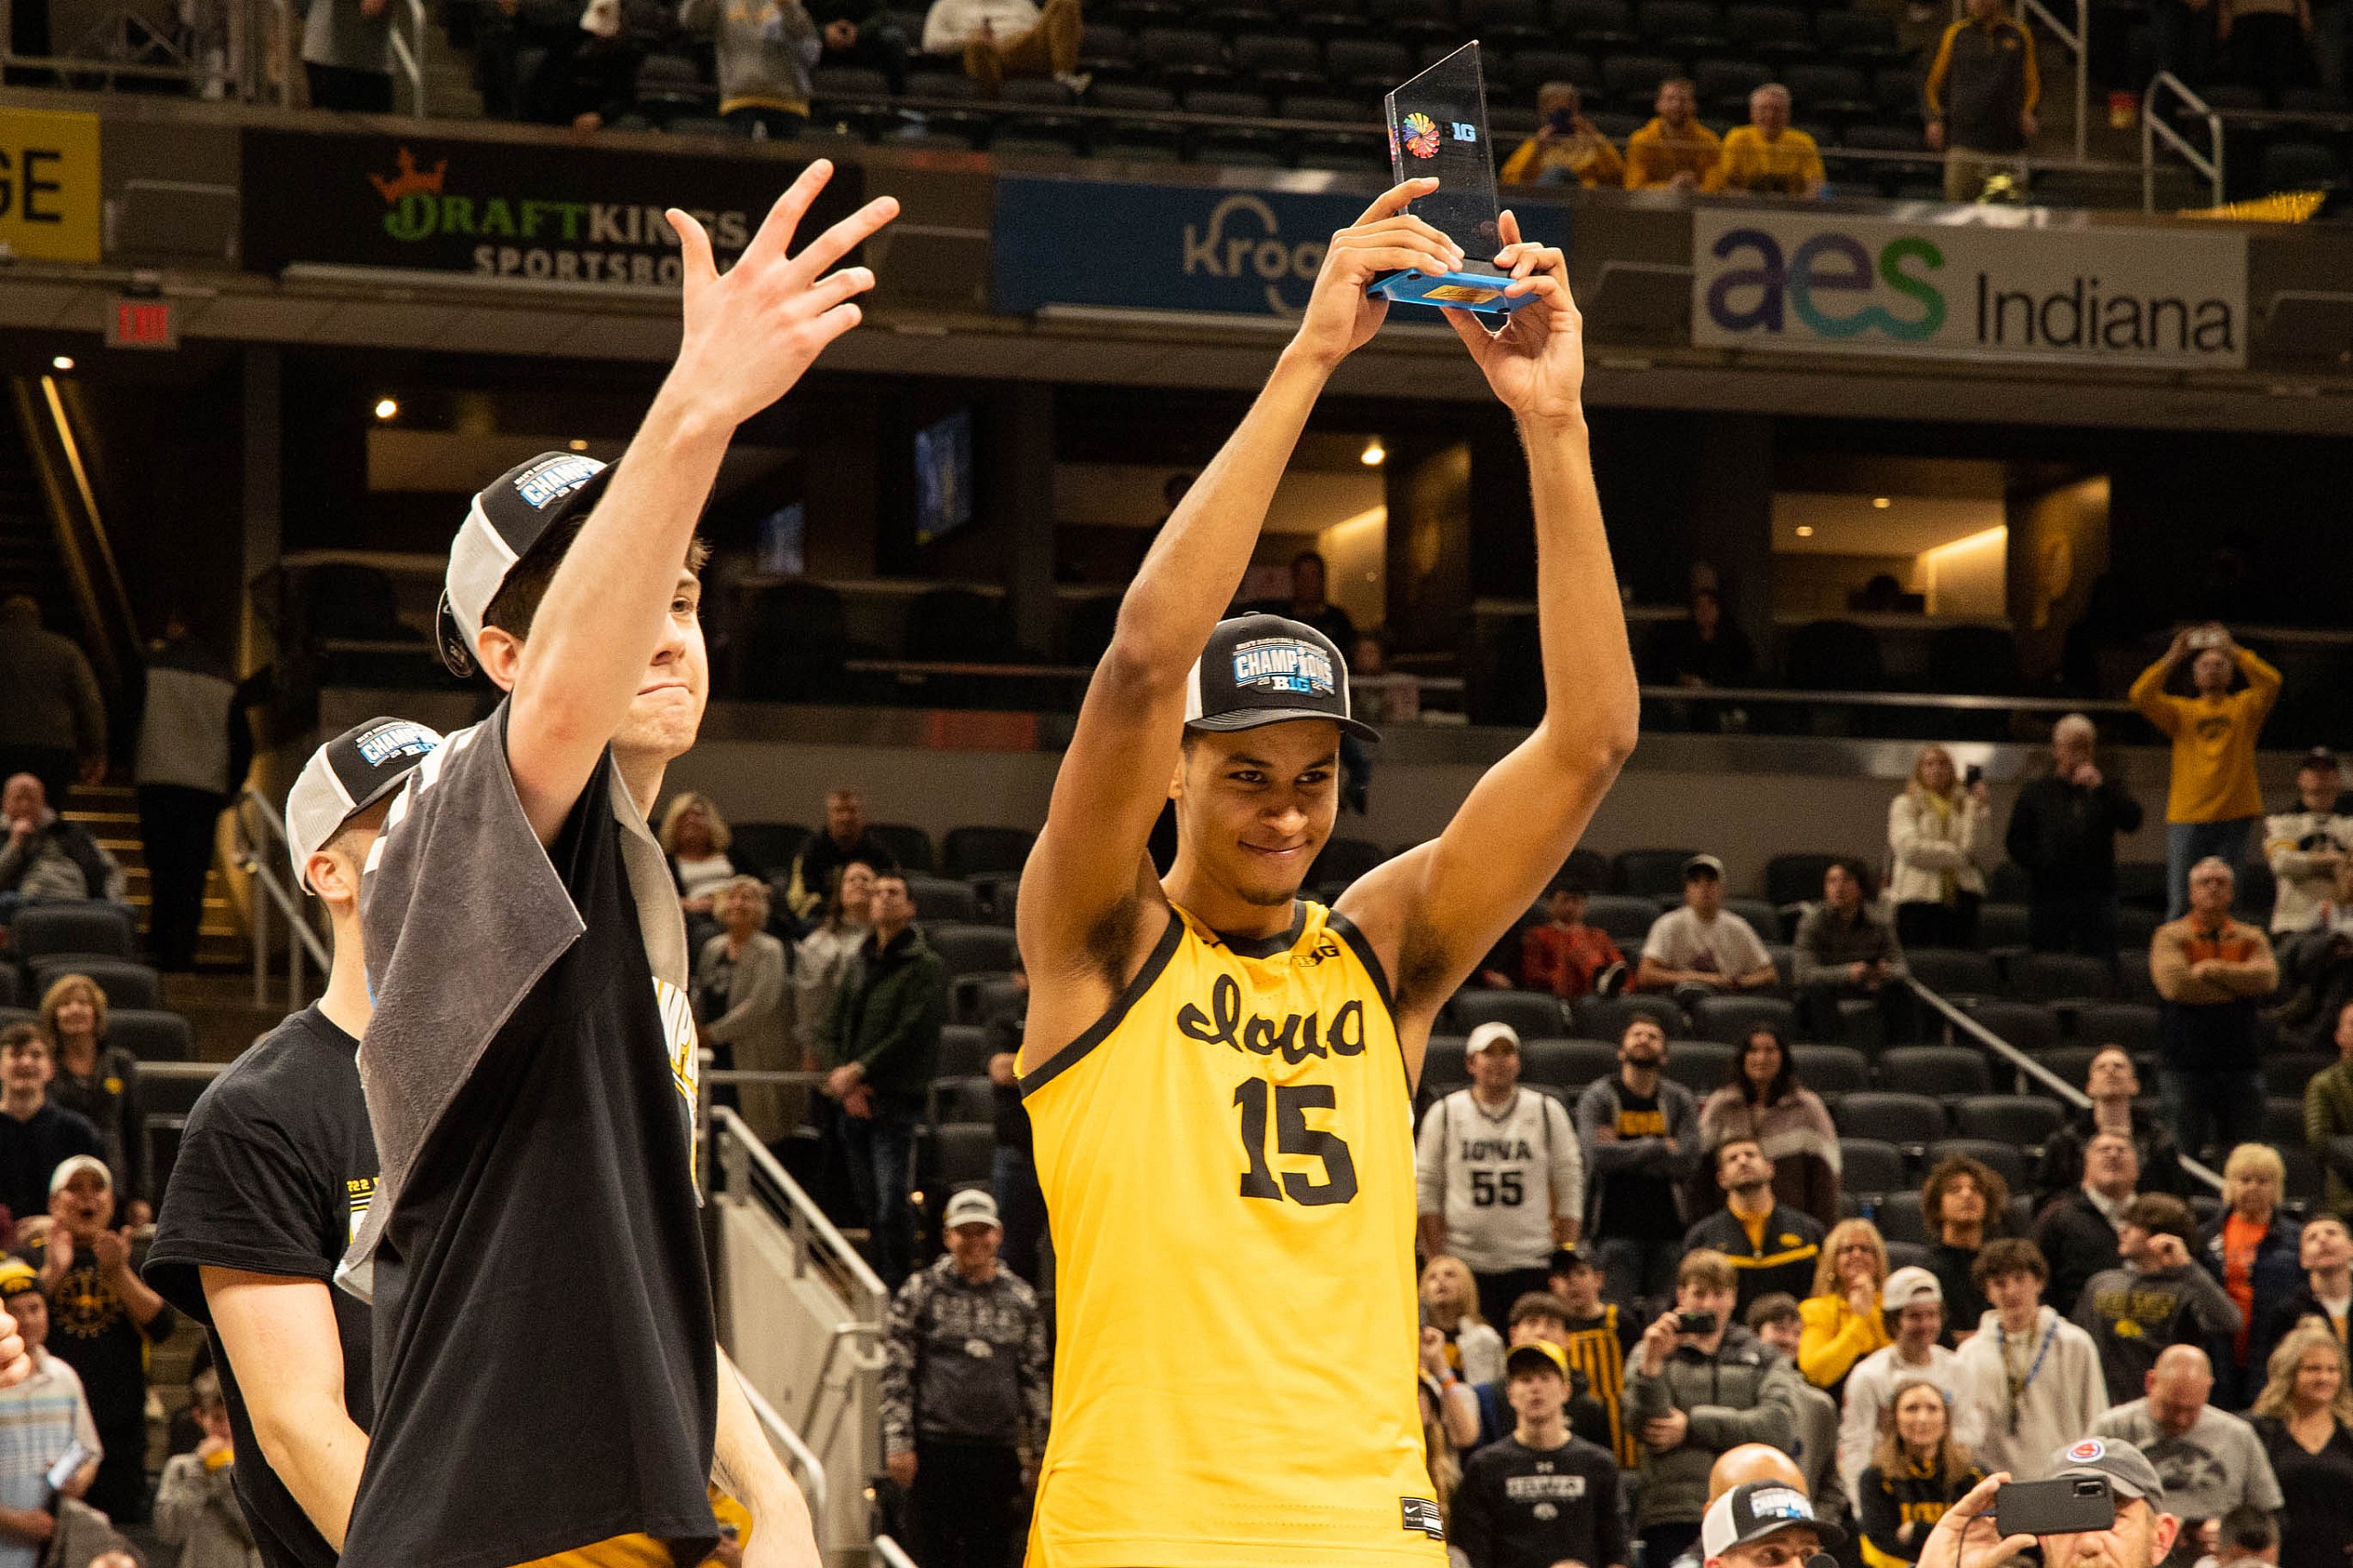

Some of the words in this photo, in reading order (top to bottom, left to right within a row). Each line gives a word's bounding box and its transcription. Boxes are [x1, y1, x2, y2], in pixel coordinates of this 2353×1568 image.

[0, 149, 62, 222] E
[472, 244, 685, 284] SPORTSBO
[1707, 228, 1946, 342] aes
[1976, 273, 2235, 353] Indiana
[1177, 974, 1366, 1064] Iowa
[1233, 1076, 1358, 1206] 15
[1461, 1140, 1532, 1160] IOWA
[1471, 1170, 1523, 1206] 55
